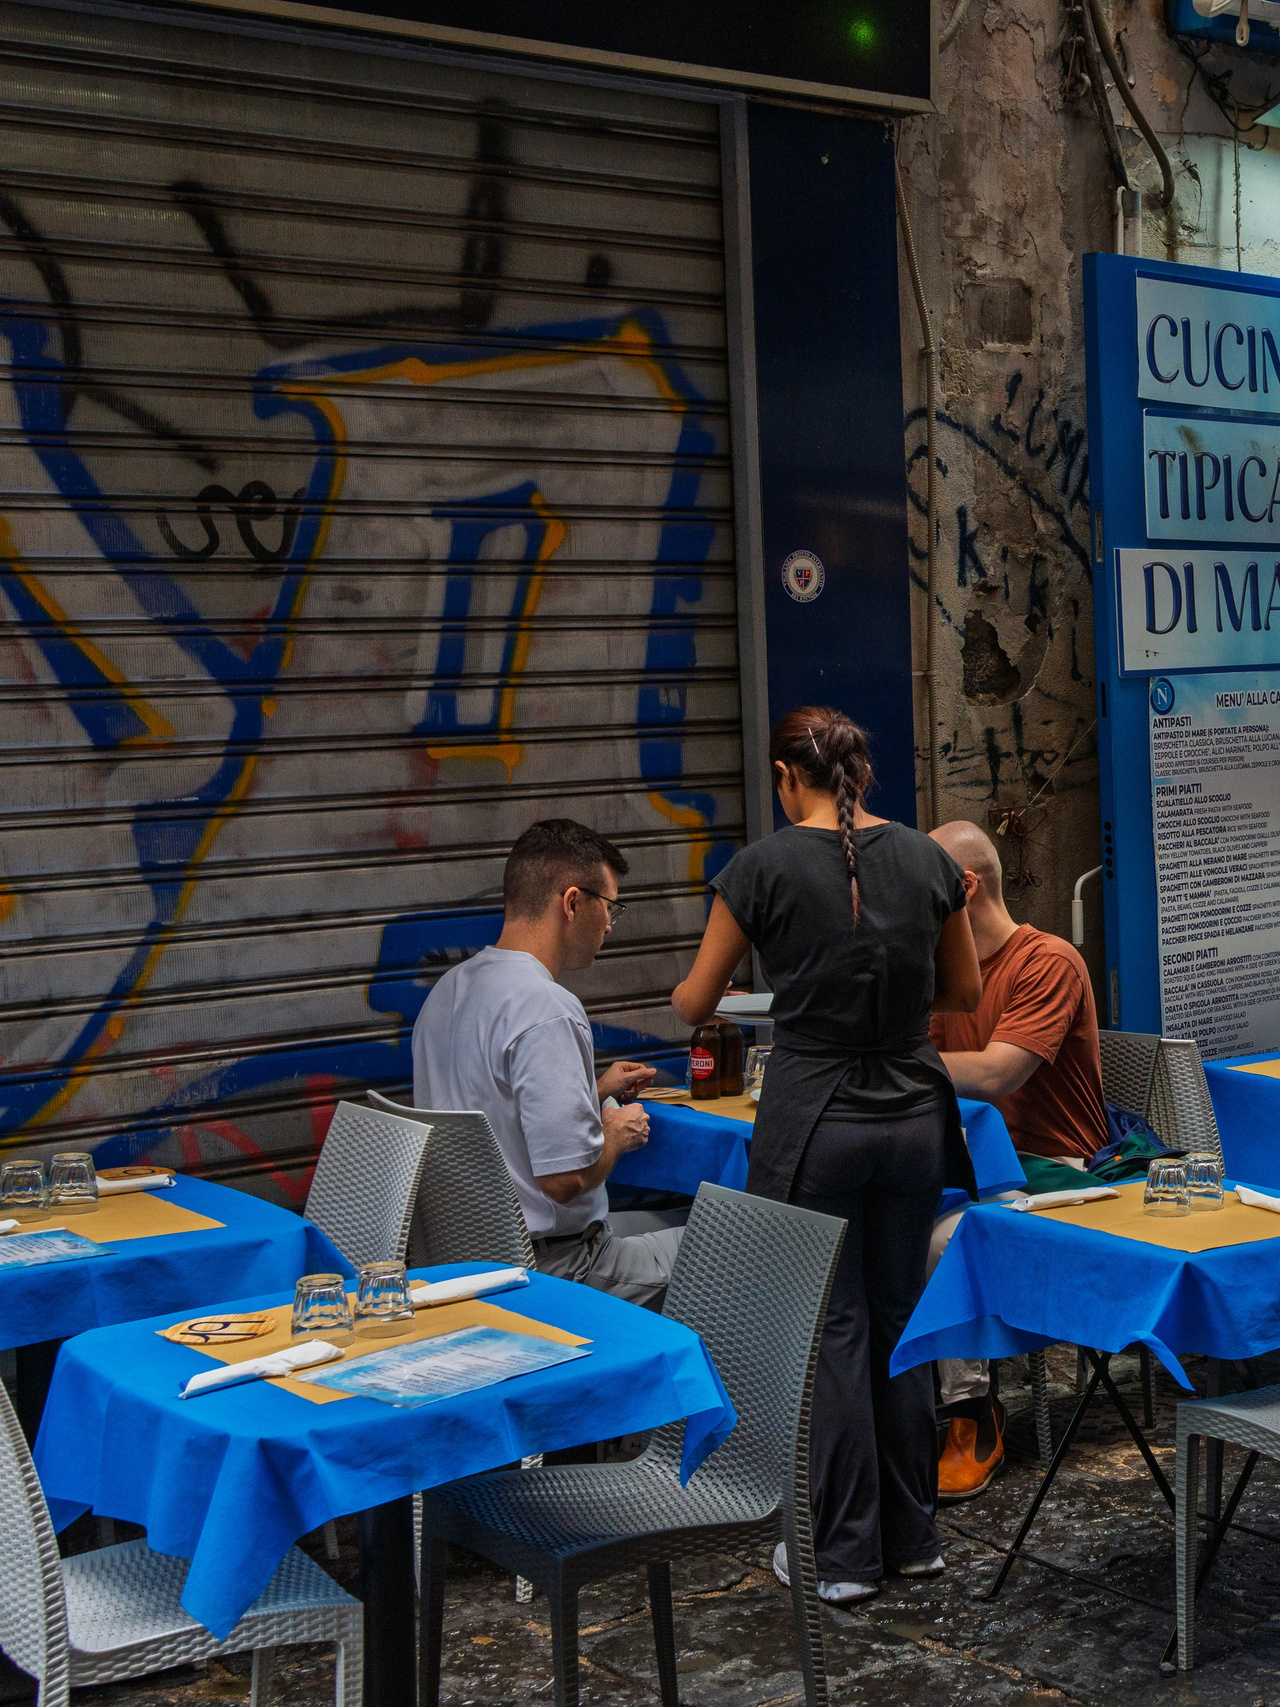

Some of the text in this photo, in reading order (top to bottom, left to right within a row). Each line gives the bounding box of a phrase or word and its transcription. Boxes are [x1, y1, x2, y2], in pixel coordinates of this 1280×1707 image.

[1142, 560, 1198, 635] DI
[1216, 692, 1244, 707] MENU'
[1246, 691, 1268, 705] ALLA
[1152, 716, 1191, 728] ANTIPASTI
[1153, 730, 1183, 740] ANTIPASTO
[1191, 728, 1206, 737] MARE
[1213, 726, 1237, 735] PORTATE
[1155, 782, 1201, 797] PRIMI PIATTI
[1156, 792, 1231, 808] SCIALATIELLO ALLO SCOGLIO
[1156, 807, 1193, 818] CALAMARATA
[1157, 815, 1220, 829] GNOCCHI ALLO SCOGLIO
[1157, 825, 1226, 840] RISOTTO ALLA PESCATORA
[1158, 840, 1184, 851] PACCHERI
[1193, 836, 1219, 847] BACCALA'
[1158, 860, 1188, 871] SPAGHETTI
[1188, 858, 1202, 867] ALLA
[1203, 855, 1225, 865] NERANO
[1232, 852, 1247, 861] MARE
[1159, 863, 1247, 882] SPAGHETTI ALLE VONGOLE VERACI
[1159, 882, 1188, 893] SPAGHETTI
[1189, 880, 1201, 889] CON
[1202, 876, 1233, 887] GAMBERONI
[1240, 871, 1265, 882] MAZZARA
[1167, 894, 1182, 903] PIATT
[1160, 913, 1188, 924] SPAGHETTI
[1188, 911, 1199, 920] CON
[1200, 906, 1231, 918] POMODORINI
[1236, 903, 1251, 912] COZZE
[1161, 924, 1186, 935] PACCHERI
[1187, 919, 1219, 931] POMODORINI
[1161, 935, 1186, 946] PACCHERI
[1187, 932, 1203, 942] PESCE
[1203, 929, 1220, 939] SPADA
[1225, 924, 1254, 935] MELANZANE
[1162, 946, 1218, 966] SECONDI PIATTI
[1163, 965, 1190, 977] CALAMARI
[1195, 959, 1225, 971] GAMBERONI
[1226, 954, 1251, 965] ARROSTITI
[1164, 983, 1189, 995] BACCALA'
[1197, 977, 1223, 989] CASSUOLA
[1164, 1003, 1182, 1014] ORATA
[1188, 998, 1210, 1009] SPIGOLA
[1211, 992, 1239, 1005] ARROSTITA
[1165, 1020, 1190, 1032] INSALATA
[1198, 1016, 1213, 1026] MARE
[691, 1060, 713, 1068] ERONI
